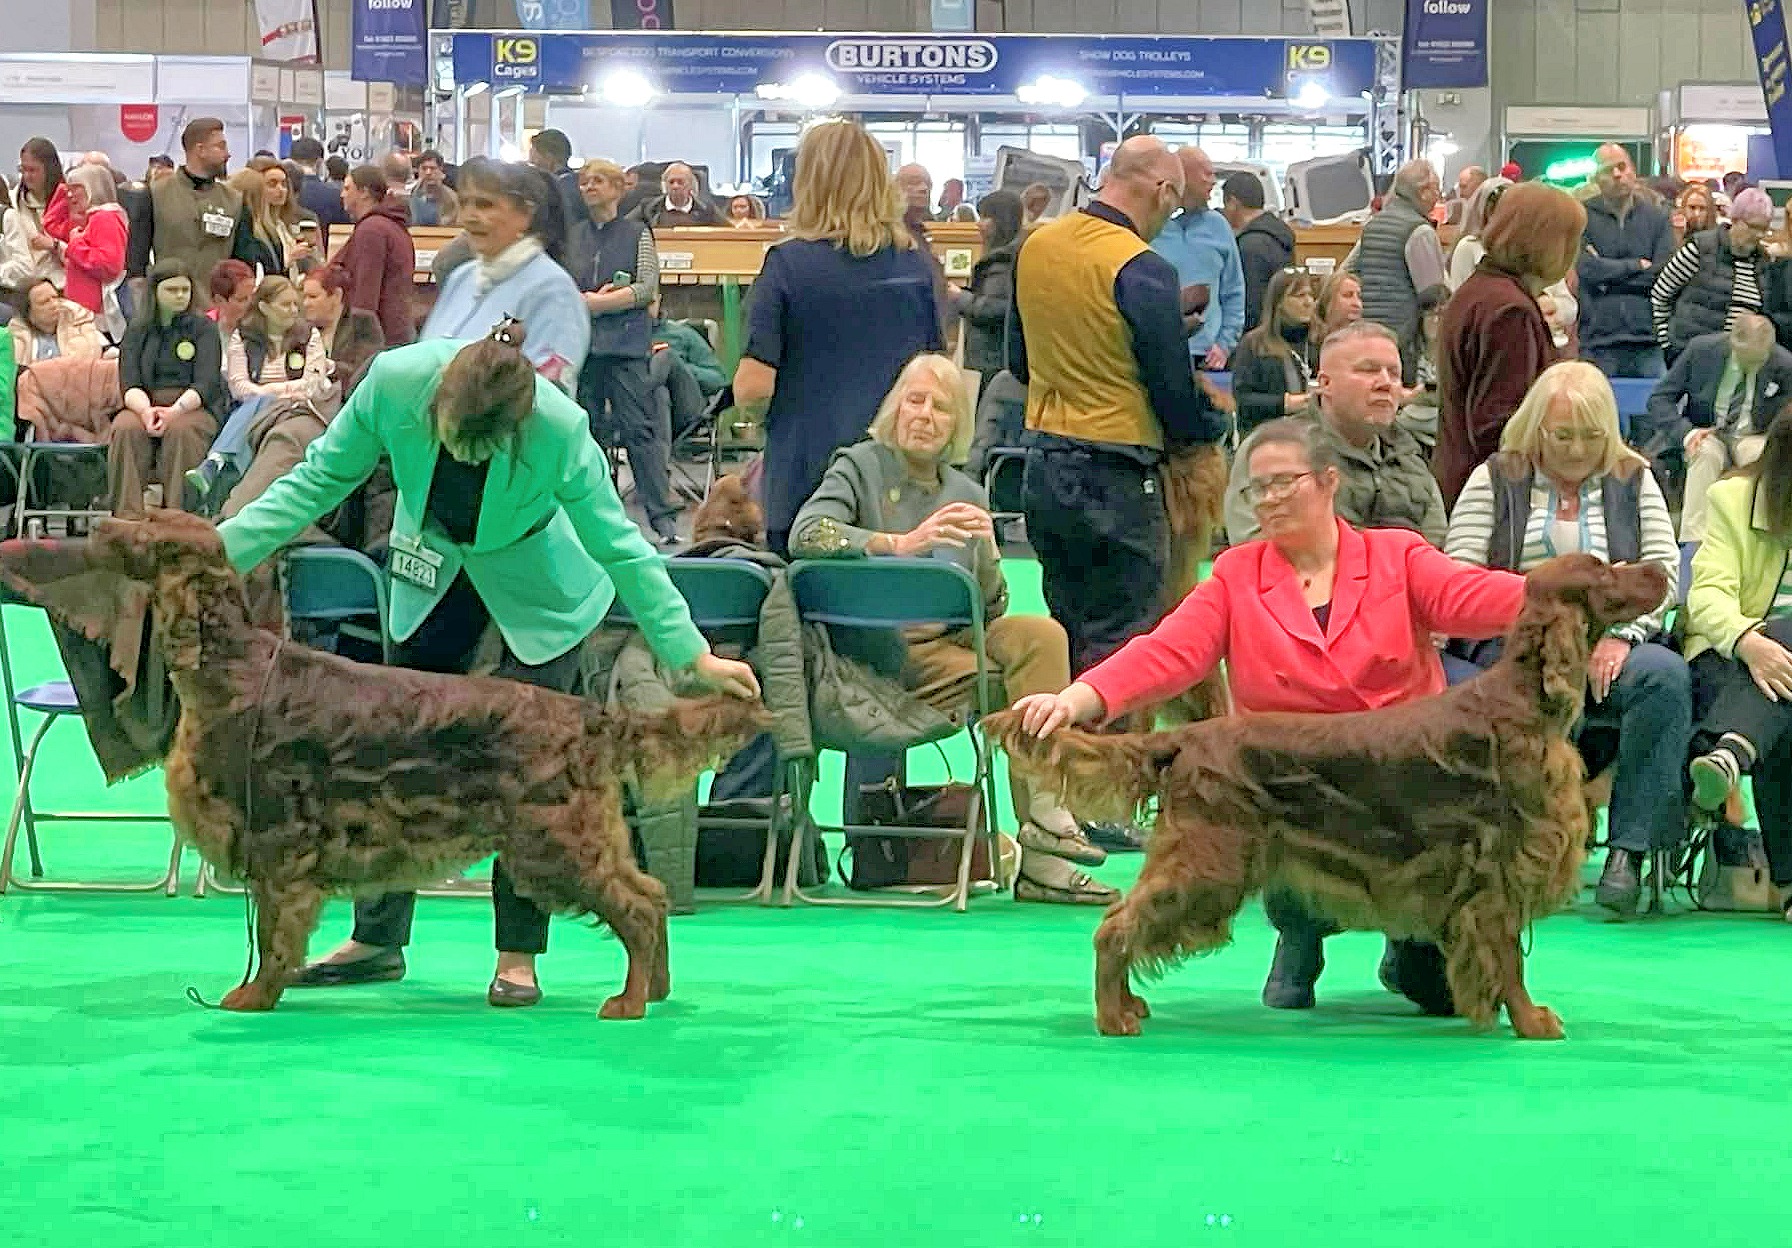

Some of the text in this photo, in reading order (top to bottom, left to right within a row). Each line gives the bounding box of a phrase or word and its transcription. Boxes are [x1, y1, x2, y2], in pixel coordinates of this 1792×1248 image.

[1423, 0, 1471, 14] follow
[496, 39, 537, 62] K9
[838, 45, 987, 67] BURTONS
[1112, 51, 1137, 61] DOG
[1139, 51, 1191, 62] TROLLEYS
[1289, 45, 1331, 69] K9
[494, 64, 537, 78] Cages
[858, 74, 966, 85] VEHICLE SYSTEMS
[342, 148, 374, 160] YOU
